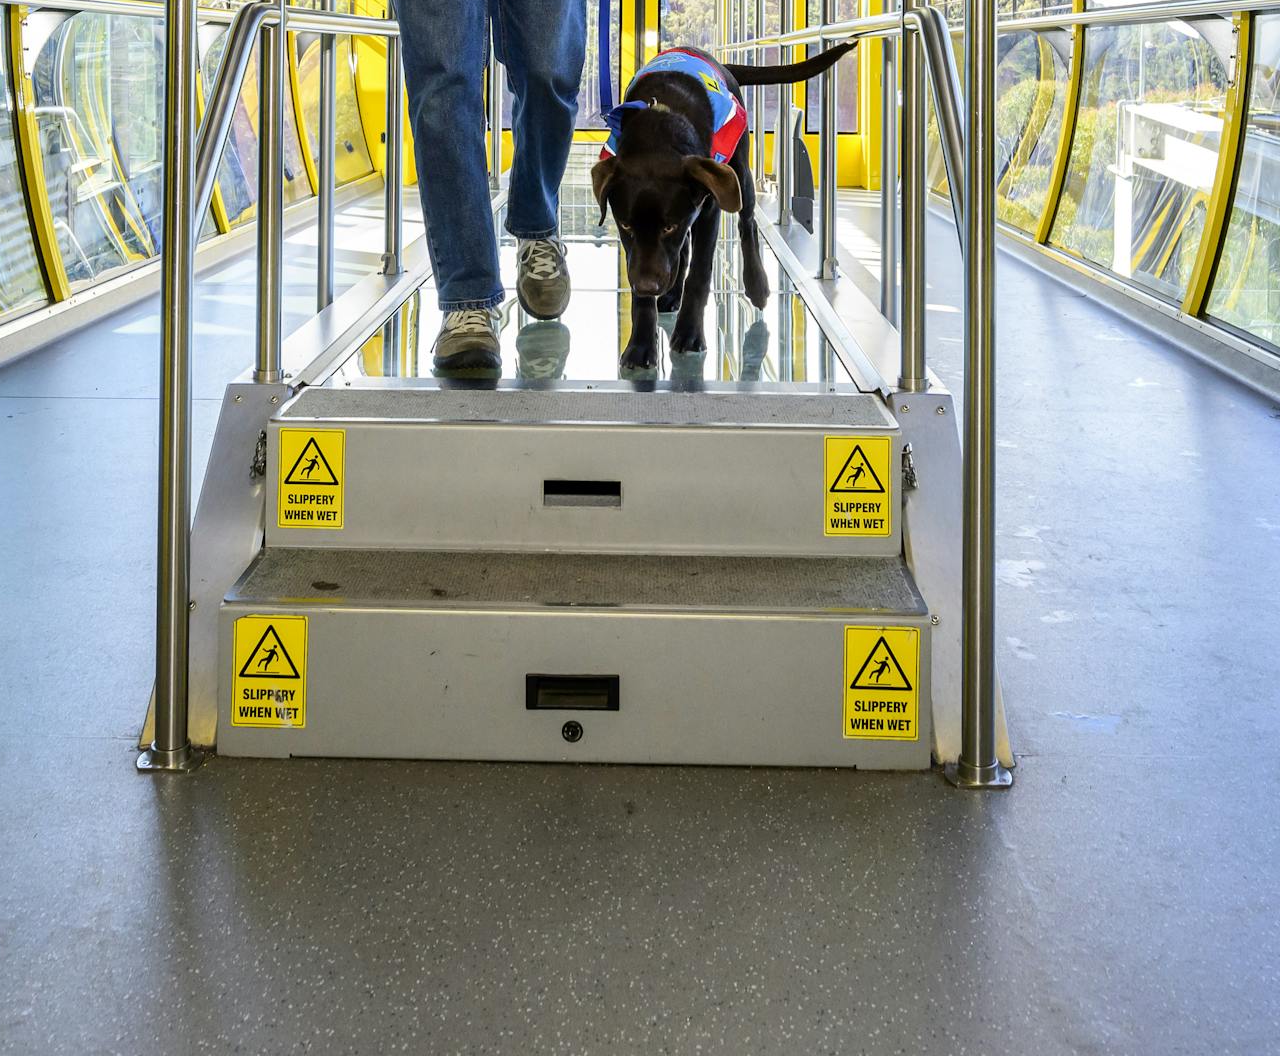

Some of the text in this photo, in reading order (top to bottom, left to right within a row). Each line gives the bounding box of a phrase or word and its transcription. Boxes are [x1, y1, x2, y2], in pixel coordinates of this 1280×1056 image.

[287, 493, 335, 505] SLIPPERY
[833, 502, 882, 513] SLIPPERY
[284, 509, 338, 521] WHEN WET
[830, 518, 885, 529] WHEN WET
[854, 700, 908, 713] SLIPPERY
[239, 706, 299, 720] WHEN WET
[850, 718, 912, 731] WHEN WET
